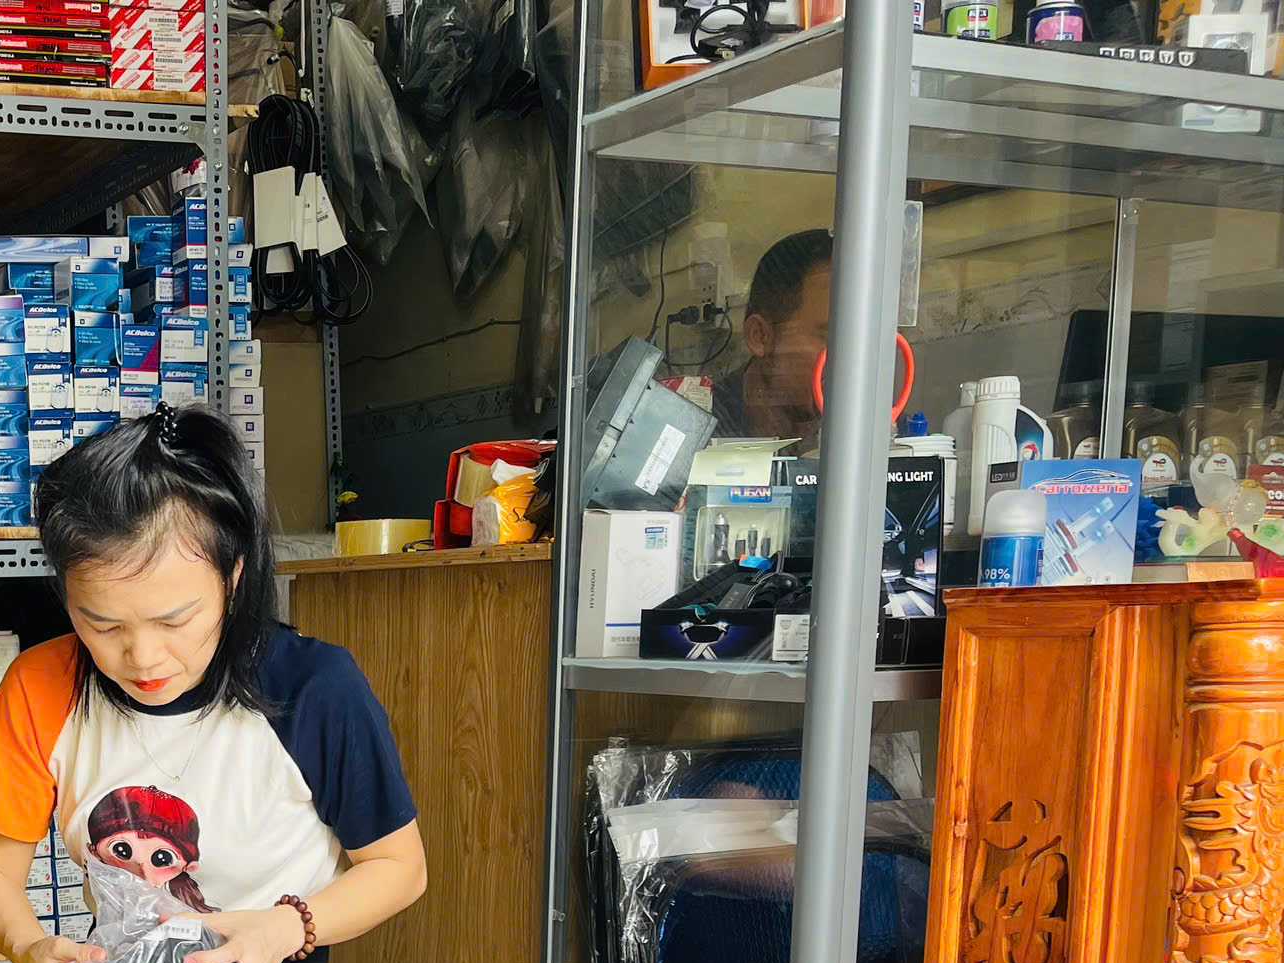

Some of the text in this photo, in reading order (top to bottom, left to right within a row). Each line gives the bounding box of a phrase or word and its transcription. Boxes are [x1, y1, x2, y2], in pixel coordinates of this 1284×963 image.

[795, 474, 818, 486] CAR
[905, 471, 934, 482] LIGHT
[991, 472, 1003, 482] LED
[1035, 483, 1130, 495] carrozzeria
[984, 567, 1011, 581] 98%
[588, 567, 597, 610] HYUNDAI
